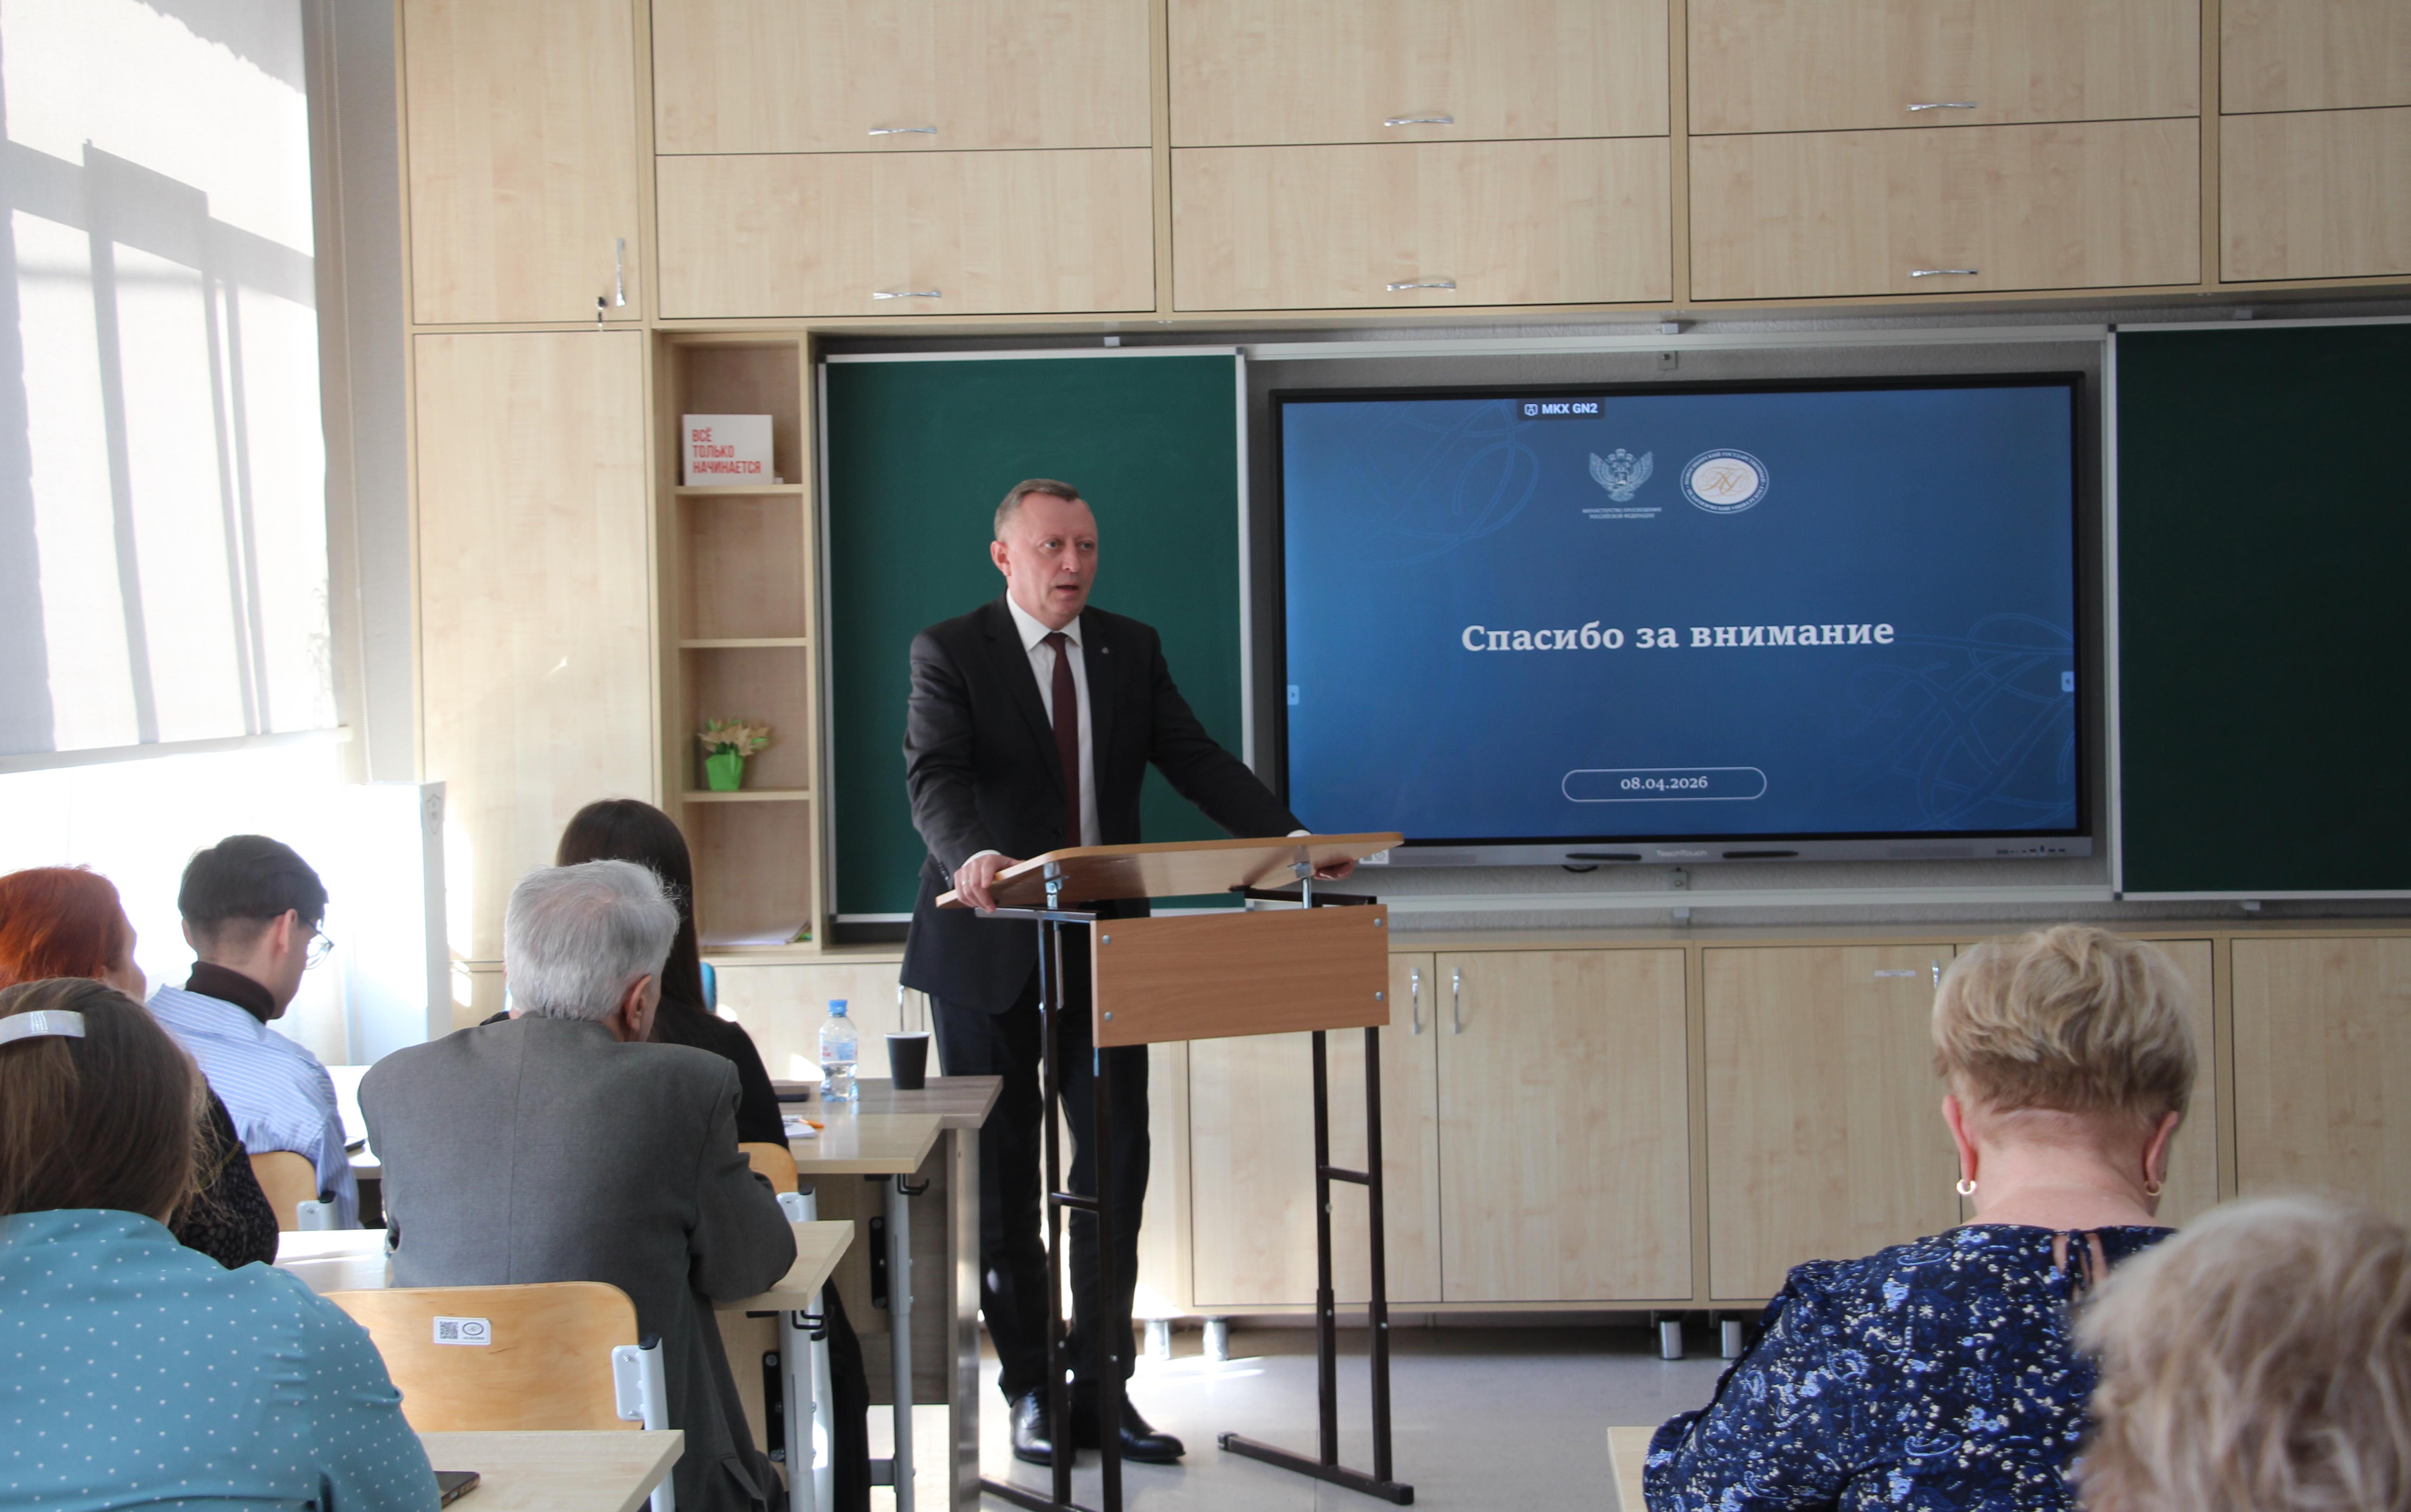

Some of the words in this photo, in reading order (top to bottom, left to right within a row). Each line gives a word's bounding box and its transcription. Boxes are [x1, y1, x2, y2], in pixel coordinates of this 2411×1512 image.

[1572, 403, 1598, 414] GN2
[692, 427, 712, 442] ВСЁ
[693, 445, 735, 458] ТОЛЬКО
[693, 461, 761, 473] НАЧИНАЕТСЯ
[1462, 620, 1624, 651] Спасибо
[1636, 626, 1679, 649] за
[1690, 623, 1894, 647] внимание
[1620, 776, 1708, 791] 08.04.2026
